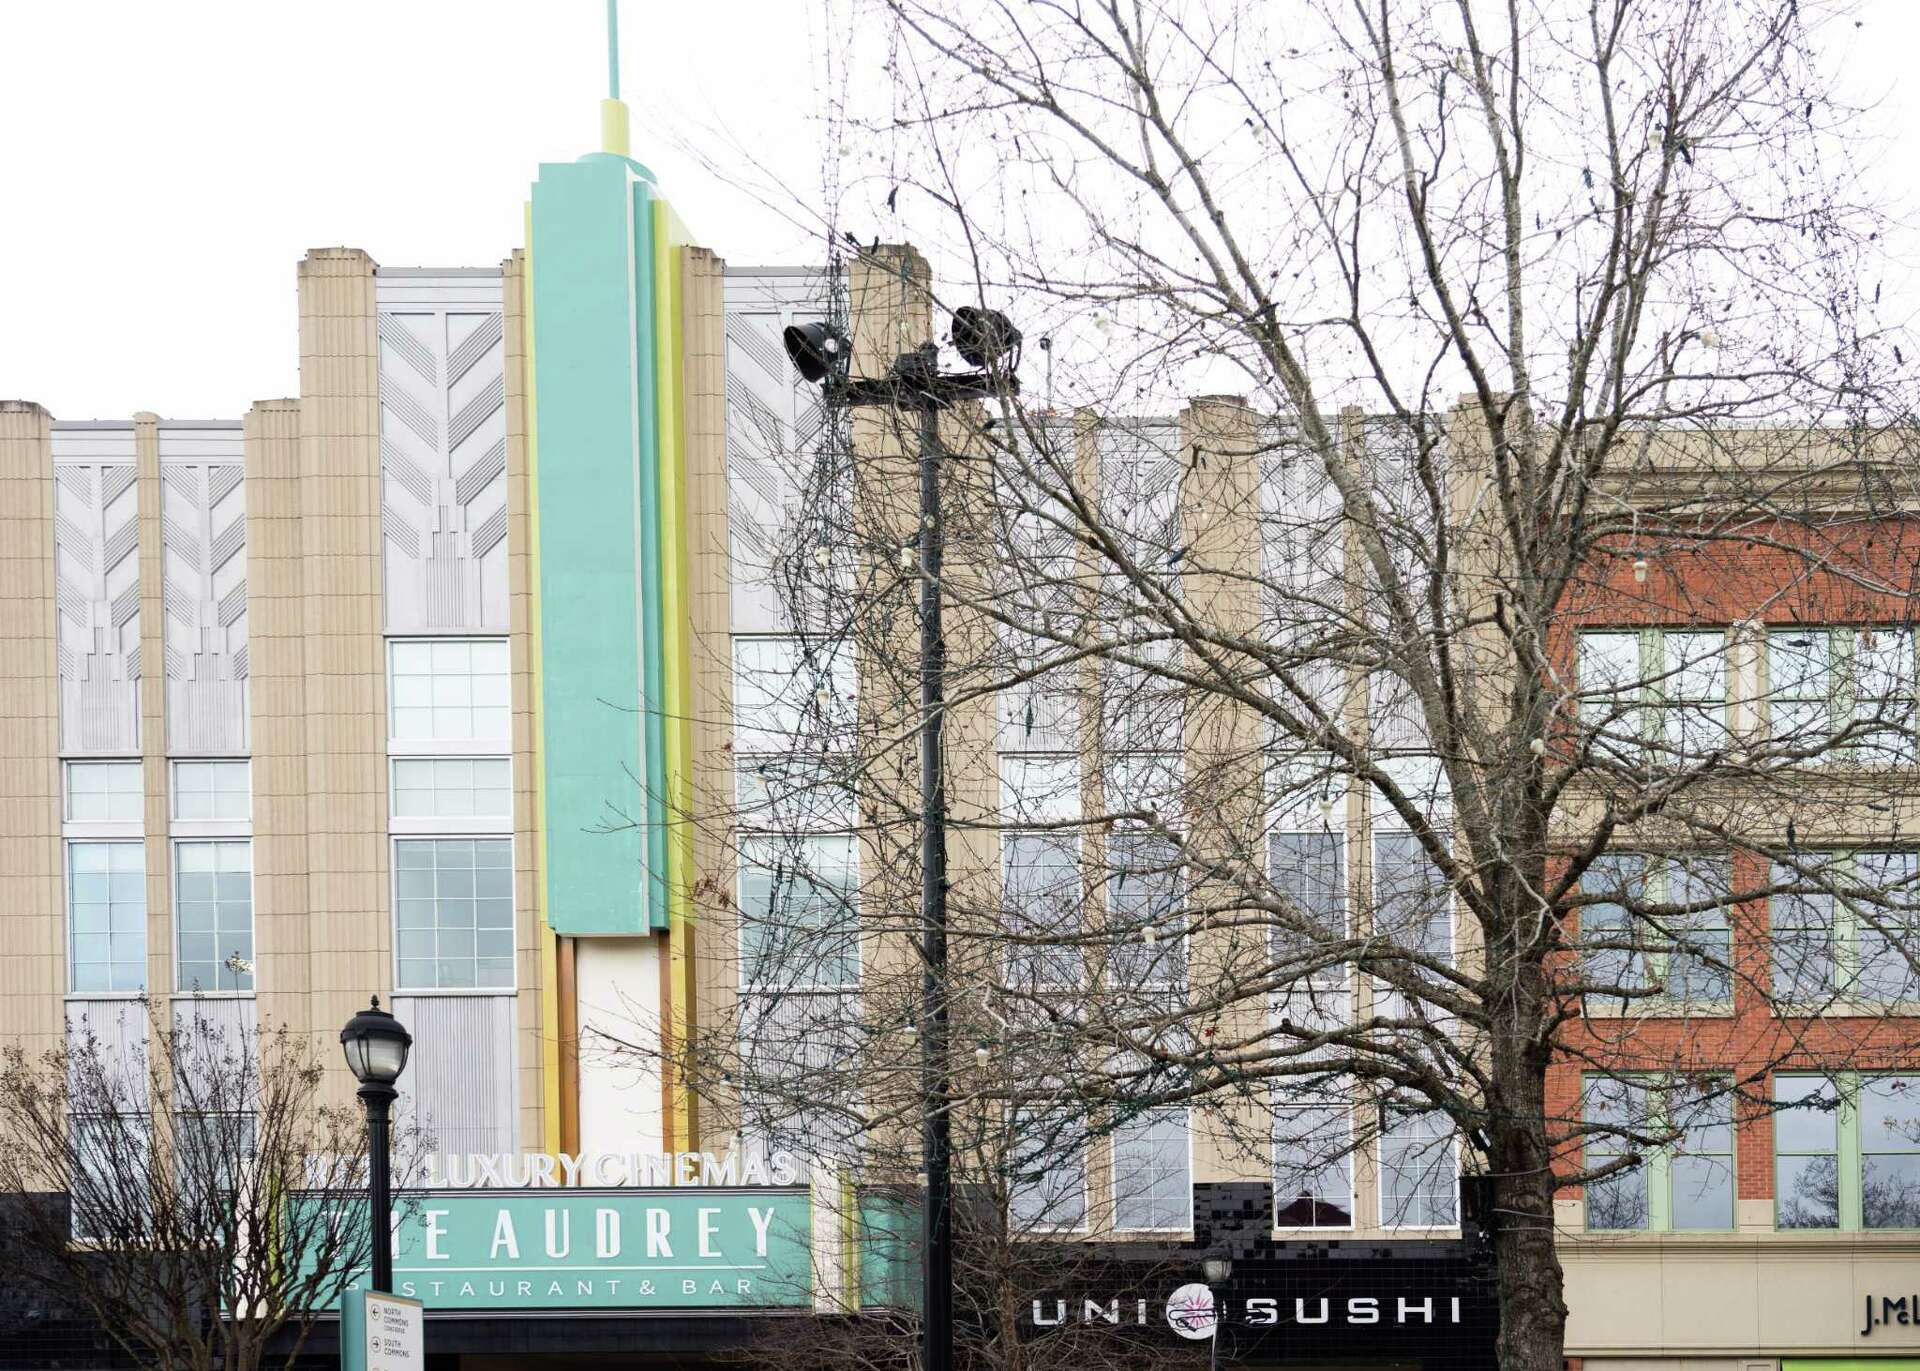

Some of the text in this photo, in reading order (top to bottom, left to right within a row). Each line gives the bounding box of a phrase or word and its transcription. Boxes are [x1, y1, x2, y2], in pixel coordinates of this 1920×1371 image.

[425, 1153, 583, 1187] LUXURY
[594, 1151, 798, 1187] CINEMAS
[490, 1207, 777, 1259] AUDREY
[345, 1279, 751, 1297] STAURANT & BAR
[383, 1307, 402, 1316] NORTH
[1032, 1297, 1460, 1325] UNI SUSHI
[383, 1316, 409, 1328] COMMONS
[384, 1338, 402, 1347] SOUTH
[384, 1347, 410, 1358] COMMONS
